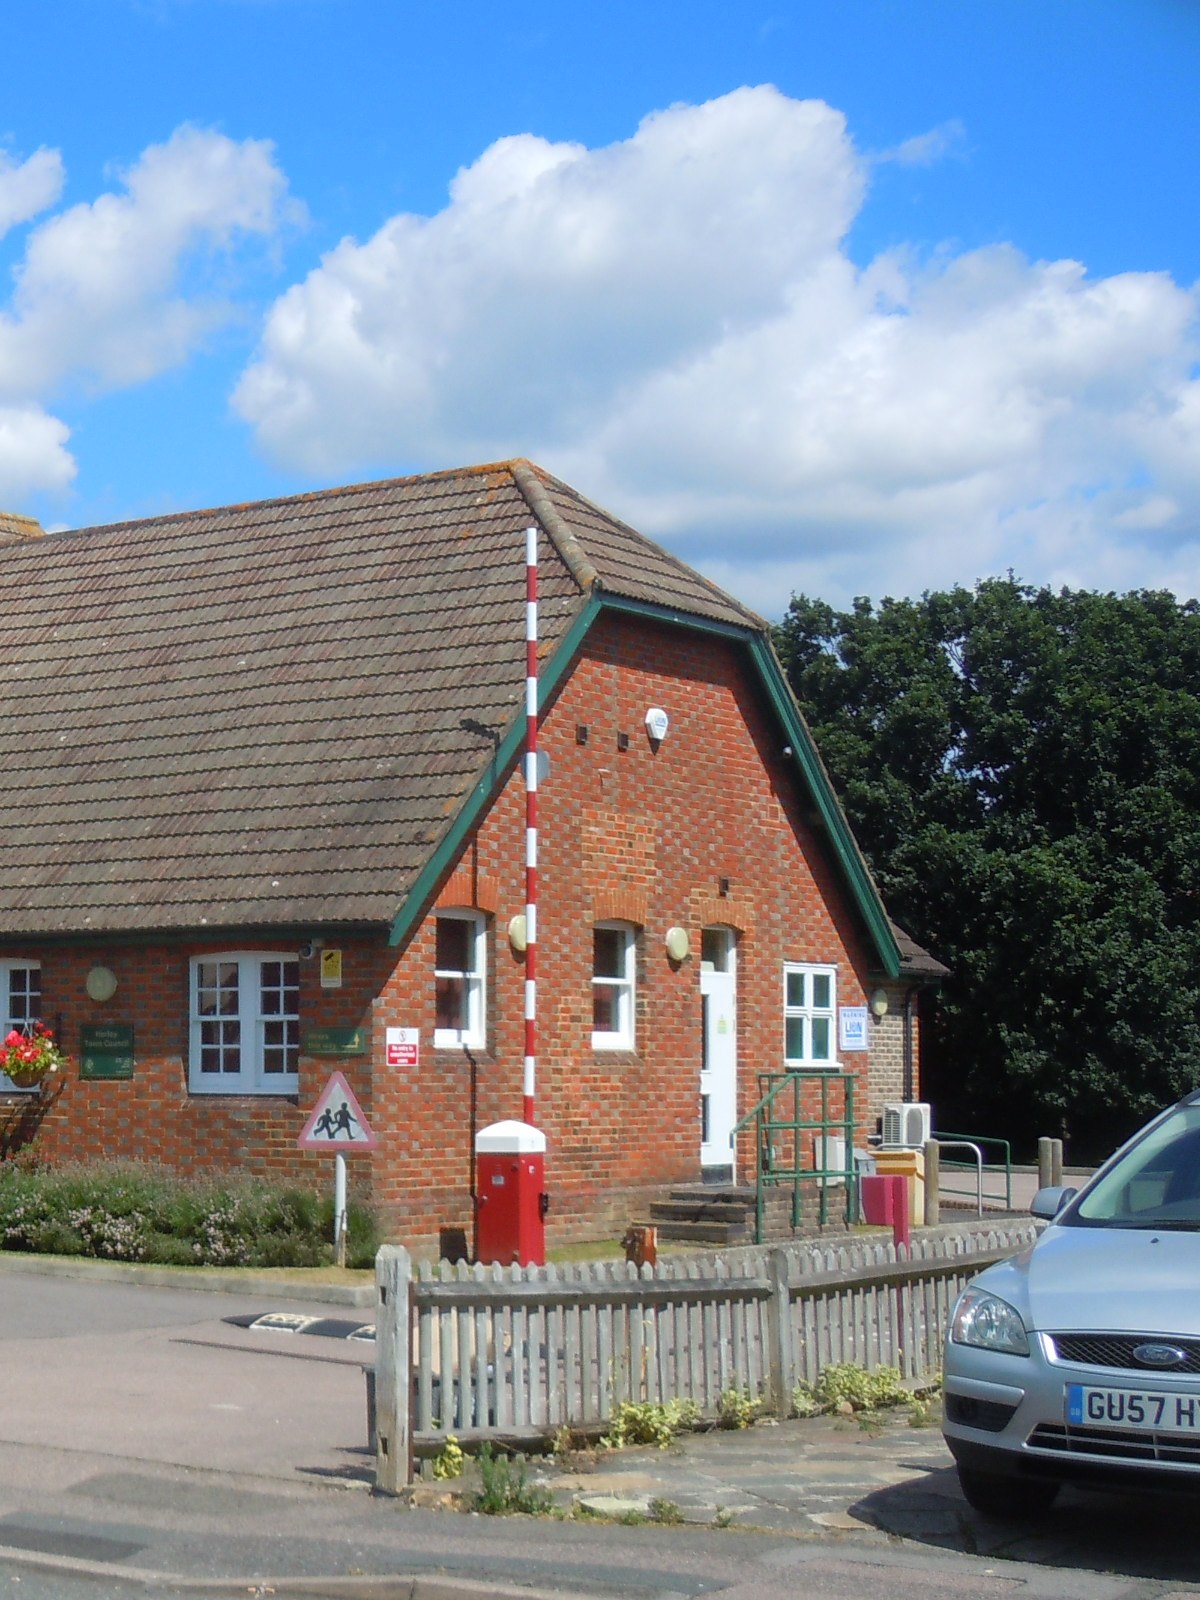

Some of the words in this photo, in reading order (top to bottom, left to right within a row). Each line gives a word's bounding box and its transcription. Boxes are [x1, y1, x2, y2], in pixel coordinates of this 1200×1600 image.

[845, 1021, 862, 1033] LION
[1142, 1347, 1171, 1360] Ford
[1087, 1391, 1166, 1425] GU57
[1175, 1397, 1200, 1428] H
